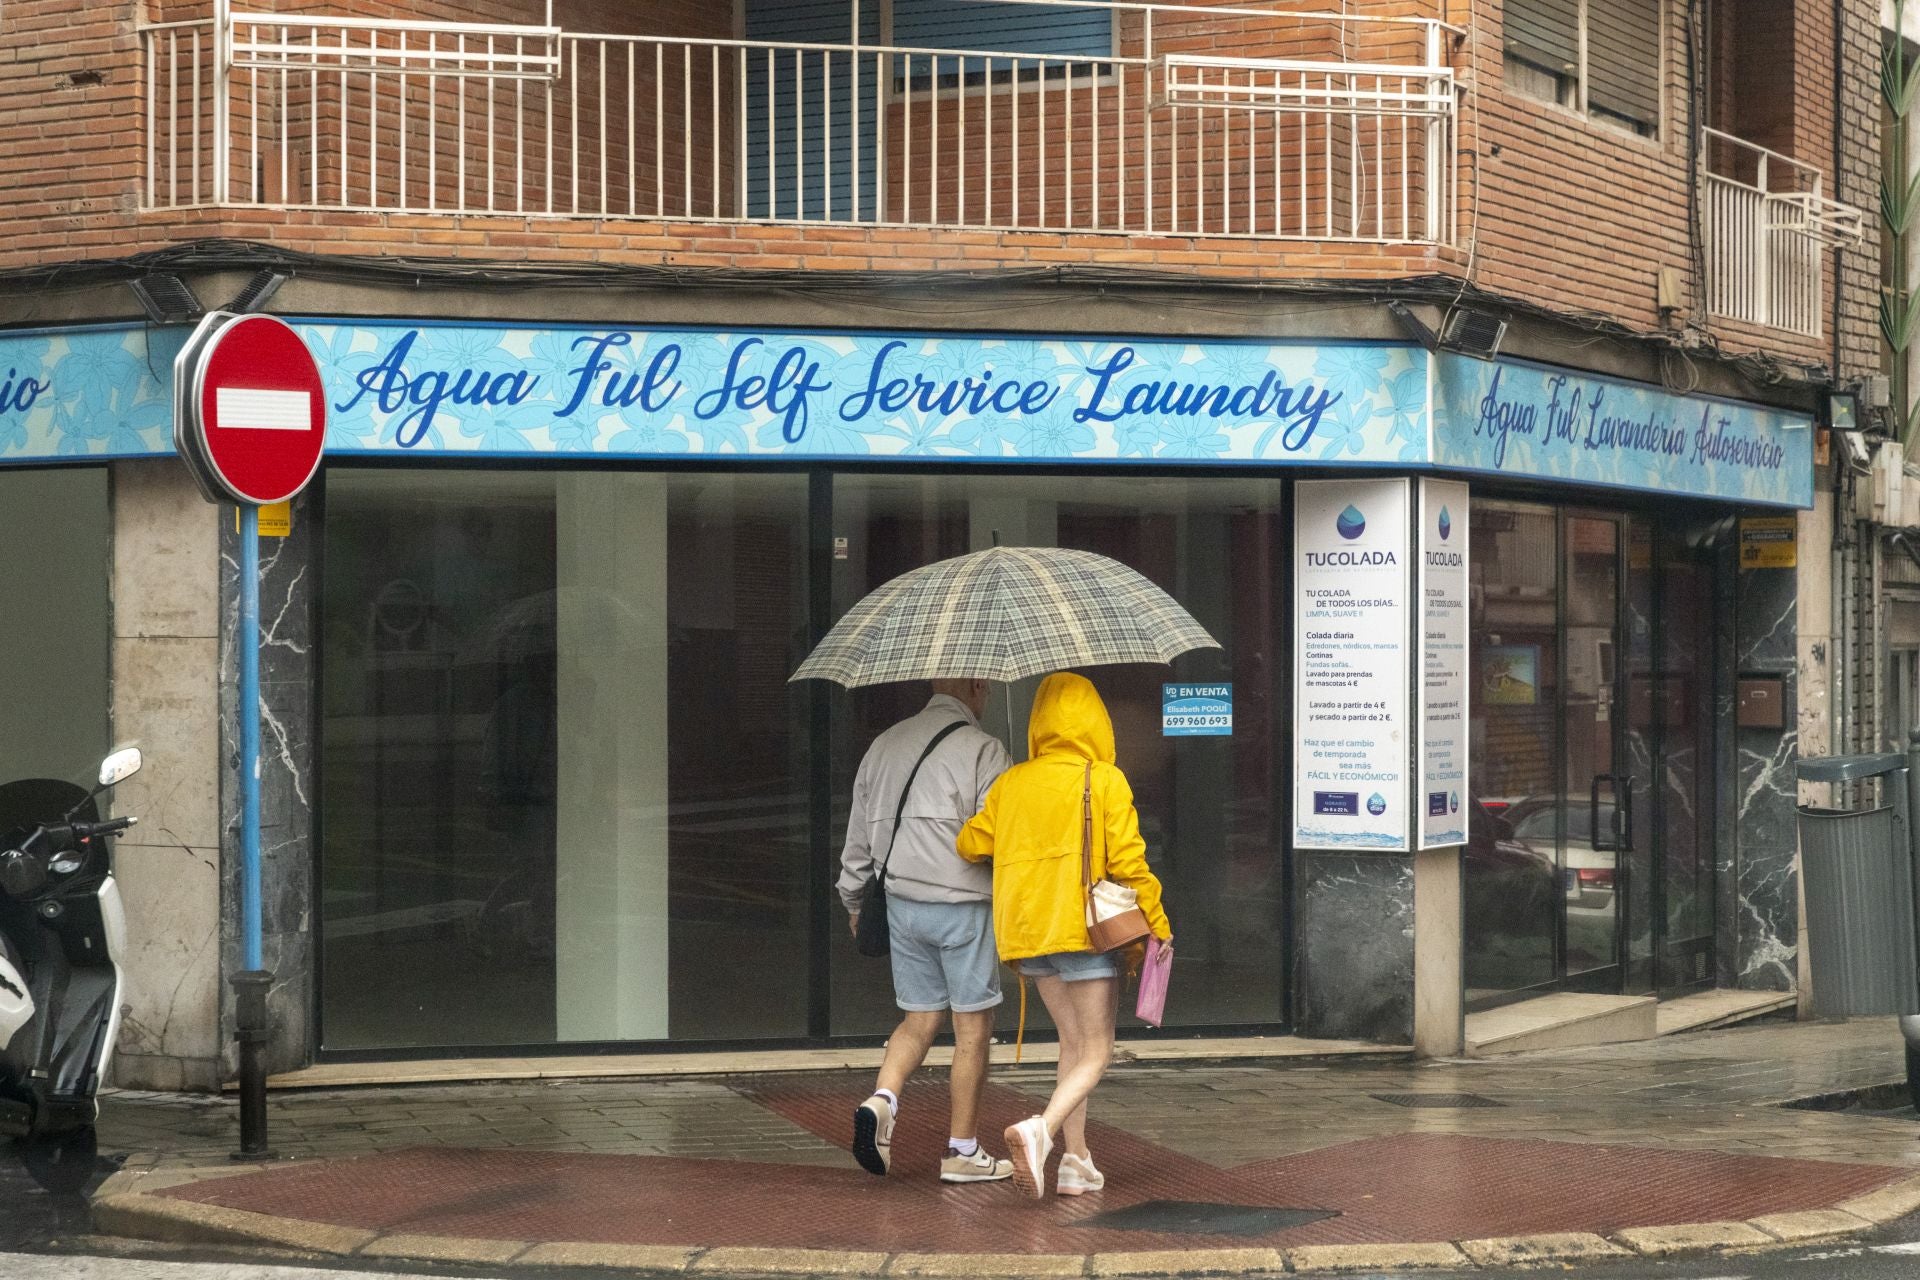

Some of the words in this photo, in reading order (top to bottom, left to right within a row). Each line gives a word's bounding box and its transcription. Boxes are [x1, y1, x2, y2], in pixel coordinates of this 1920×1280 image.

[335, 330, 539, 448] Agua
[553, 332, 683, 417] Ful
[693, 337, 833, 444] Self
[838, 340, 1060, 422] Service
[1073, 346, 1343, 452] Laundry
[1473, 366, 1538, 469] Agua
[1541, 375, 1582, 446] Ful
[1689, 404, 1785, 470] Autoservicio
[1305, 551, 1397, 567] TUCOLADA
[1425, 551, 1463, 567] TUCOLADA
[1317, 589, 1351, 597] COLADA
[1316, 600, 1326, 608] DE
[1328, 599, 1356, 607] TODOS
[1357, 599, 1372, 607] LOS
[1305, 610, 1332, 618] LIMPIA,
[1306, 631, 1332, 639] Colada
[1333, 631, 1355, 639] diaria
[1306, 642, 1342, 650] Edredones,
[1342, 642, 1373, 650] nórdicos,
[1306, 651, 1333, 659] Cortinas
[1180, 687, 1194, 697] EN
[1194, 687, 1229, 696] VENTA
[1167, 705, 1200, 713] Elisabeth
[1309, 701, 1336, 709] Lavado
[1343, 701, 1362, 709] partir
[1363, 701, 1373, 709] de
[1373, 701, 1379, 709] 4
[1380, 701, 1386, 709] €
[1166, 717, 1185, 726] 699
[1187, 716, 1206, 726] 960
[1208, 716, 1228, 725] 693
[1315, 713, 1341, 721] secado
[1348, 713, 1367, 722] partir
[1368, 713, 1378, 721] de
[1379, 713, 1384, 721] 2
[1303, 739, 1319, 747] Haz
[1320, 740, 1336, 748] que
[1345, 739, 1375, 747] cambio
[1313, 750, 1323, 758] de
[1324, 750, 1367, 759] temporada
[1307, 771, 1331, 779] FÁCIL
